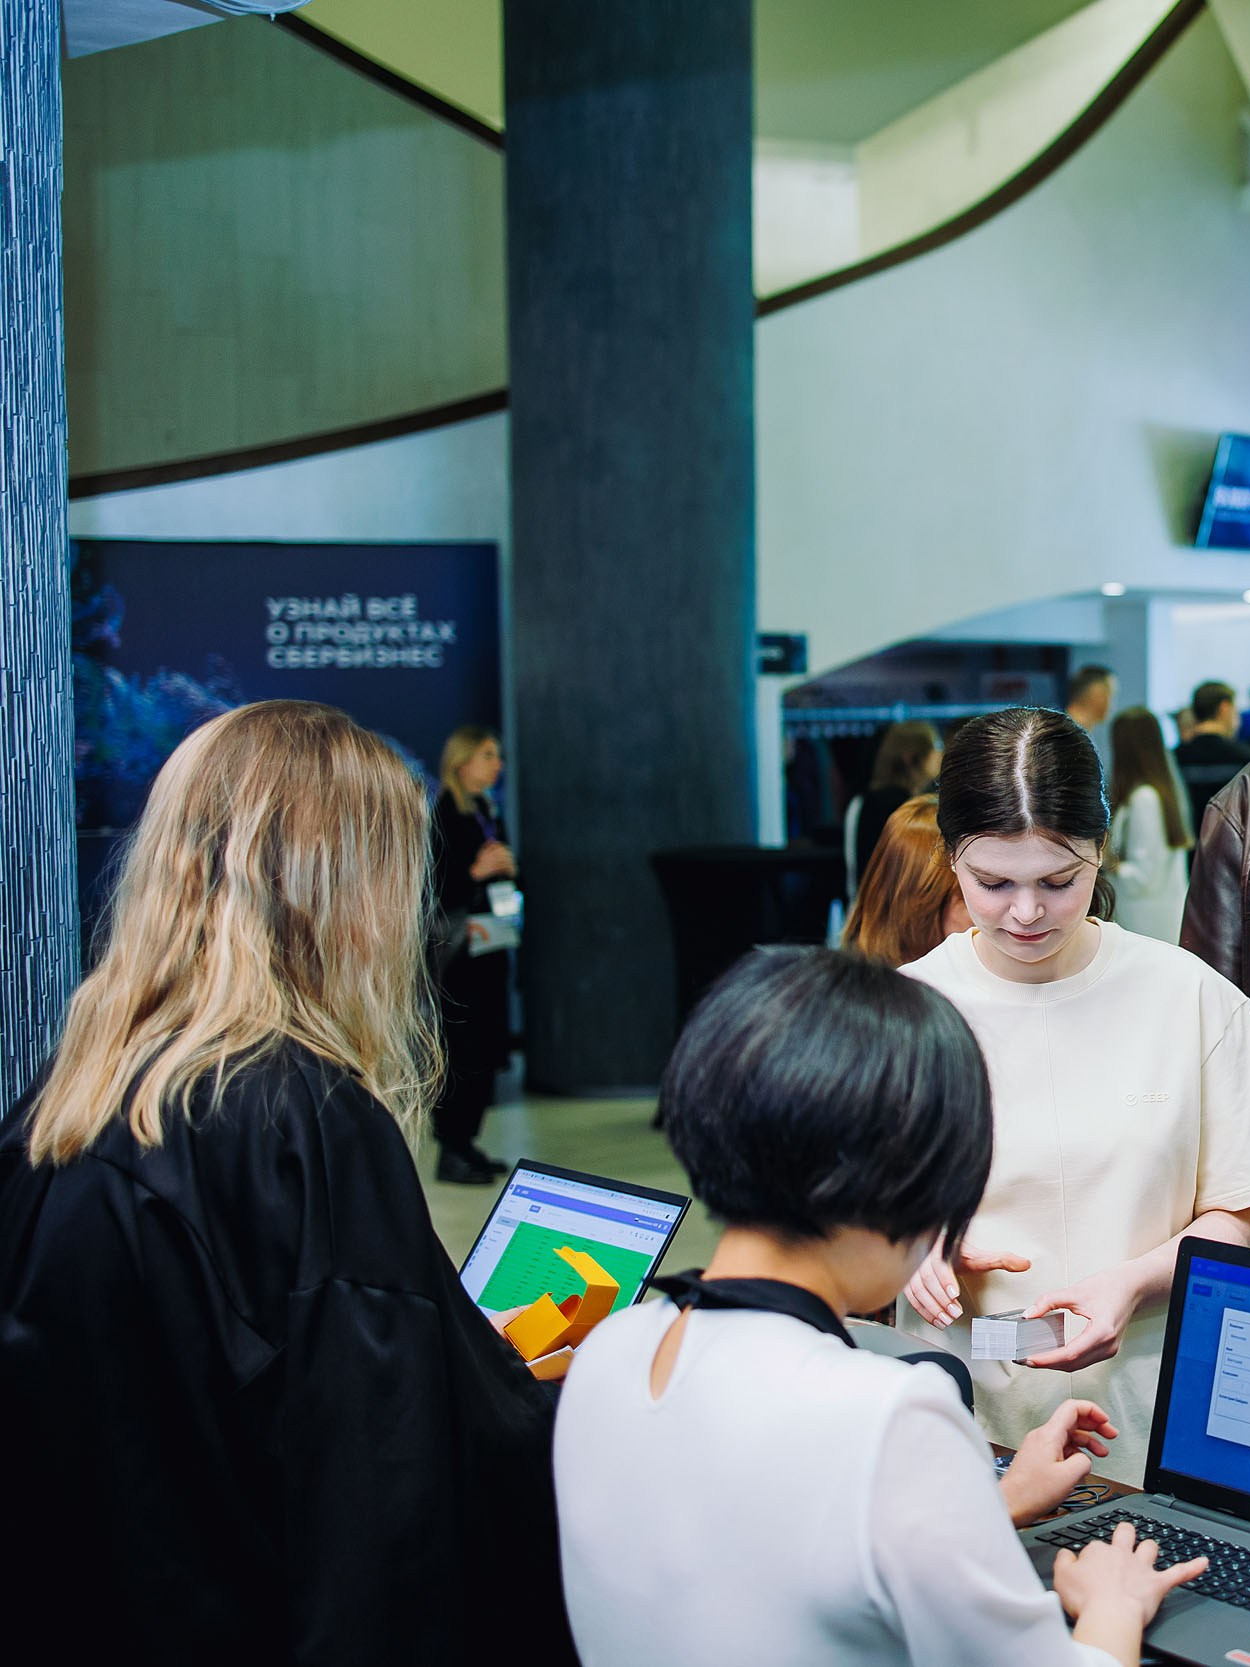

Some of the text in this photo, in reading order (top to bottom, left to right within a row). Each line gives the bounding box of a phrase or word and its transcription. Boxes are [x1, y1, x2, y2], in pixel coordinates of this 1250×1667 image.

[266, 593, 361, 621] УЗНАЙ
[267, 621, 457, 645] О ПРОДУКТАХ
[267, 645, 443, 669] СБЕРБИЗНЕС
